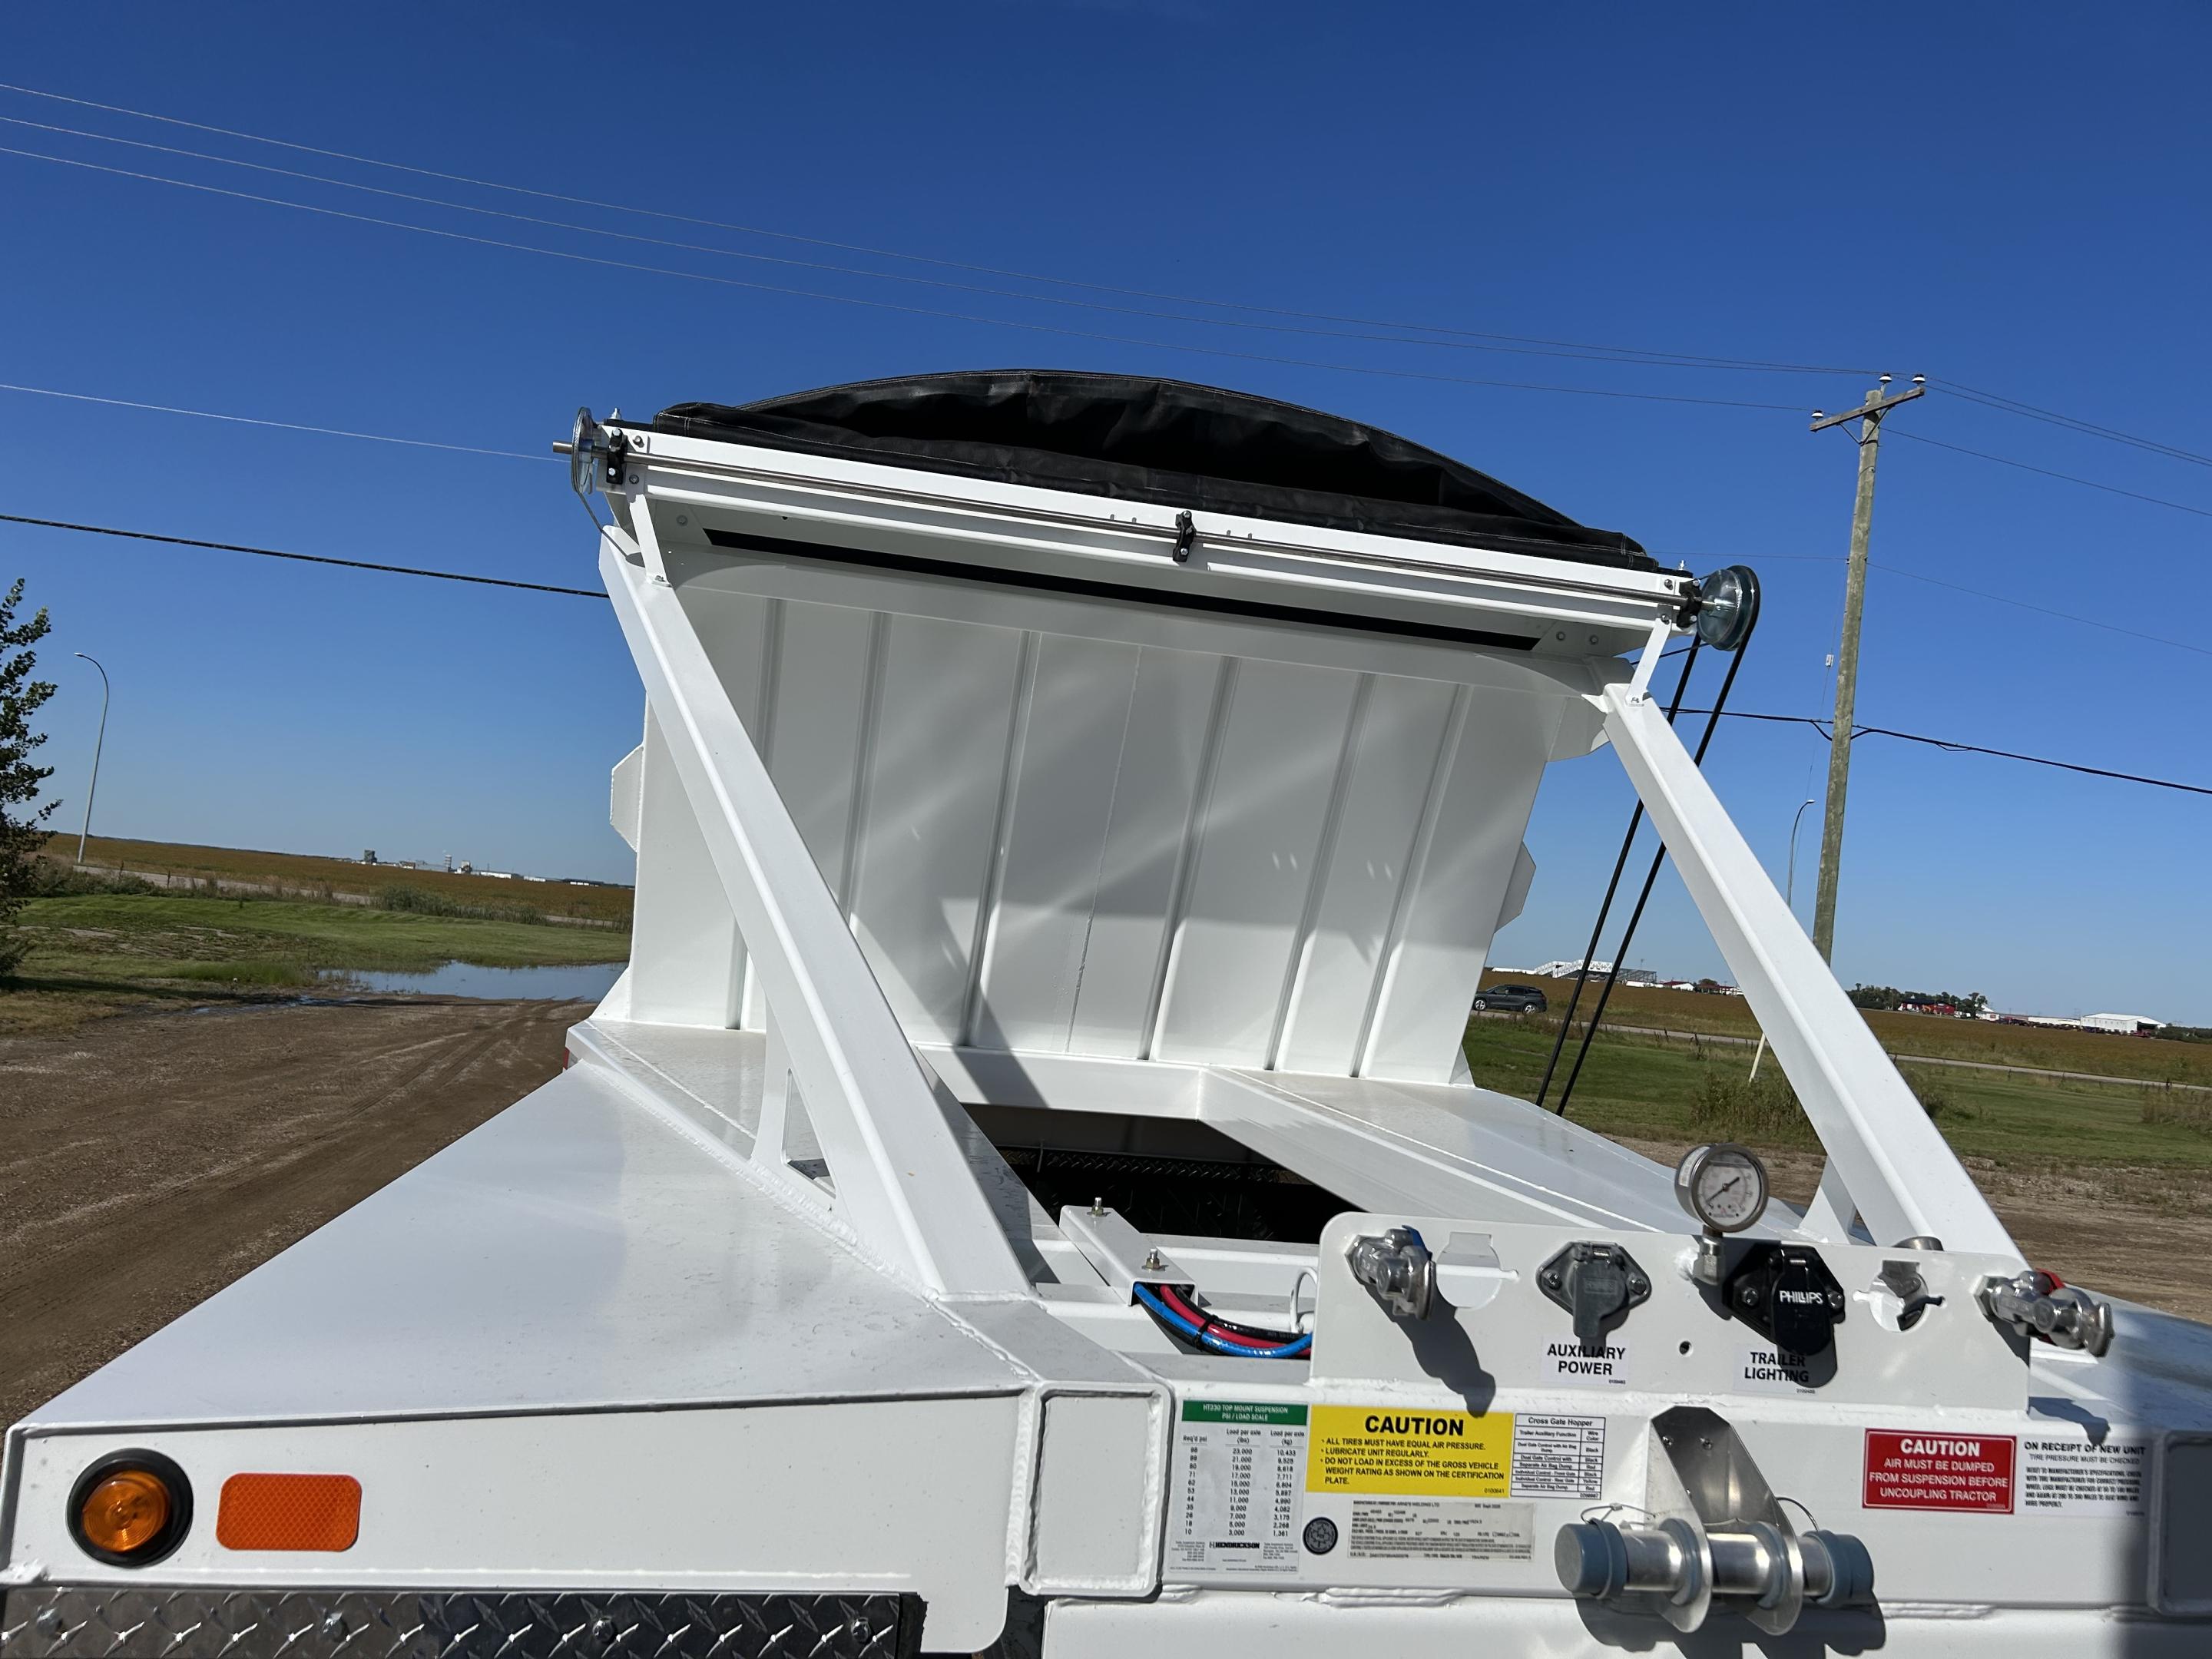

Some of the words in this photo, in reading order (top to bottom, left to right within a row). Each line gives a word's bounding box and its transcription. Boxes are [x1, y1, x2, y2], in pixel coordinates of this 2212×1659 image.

[1780, 1290, 1823, 1304] PHILLIPS
[1548, 1344, 1625, 1359] AUXILIARY
[1750, 1352, 1805, 1366] TRAILER
[1558, 1361, 1612, 1375] POWER
[1745, 1367, 1809, 1382] LIGHTING
[1365, 1416, 1464, 1436] CAUTION
[1568, 1419, 1593, 1427] Hopper
[1407, 1440, 1431, 1449] EQUAL
[1900, 1438, 1980, 1457] CAUTION
[2025, 1442, 2038, 1450] ON
[2041, 1442, 2082, 1452] RECEIPT
[2085, 1444, 2098, 1453] OF
[2099, 1445, 2121, 1454] NEW
[2123, 1445, 2146, 1455] UNIT
[1884, 1457, 1902, 1469] AIR
[1903, 1459, 1933, 1469] MUST
[1936, 1460, 1949, 1470] BE
[1951, 1461, 1995, 1472] DUMPED
[2109, 1456, 2140, 1465] CHECKED
[1452, 1471, 1505, 1480] CERTIFICATION
[1869, 1472, 1899, 1483] FROM
[1901, 1473, 1966, 1486] SUSPENSION
[1969, 1477, 2008, 1488] BEFORE
[1880, 1487, 1946, 1499] UNCOUPLING
[1950, 1490, 1996, 1502] TRACTOR
